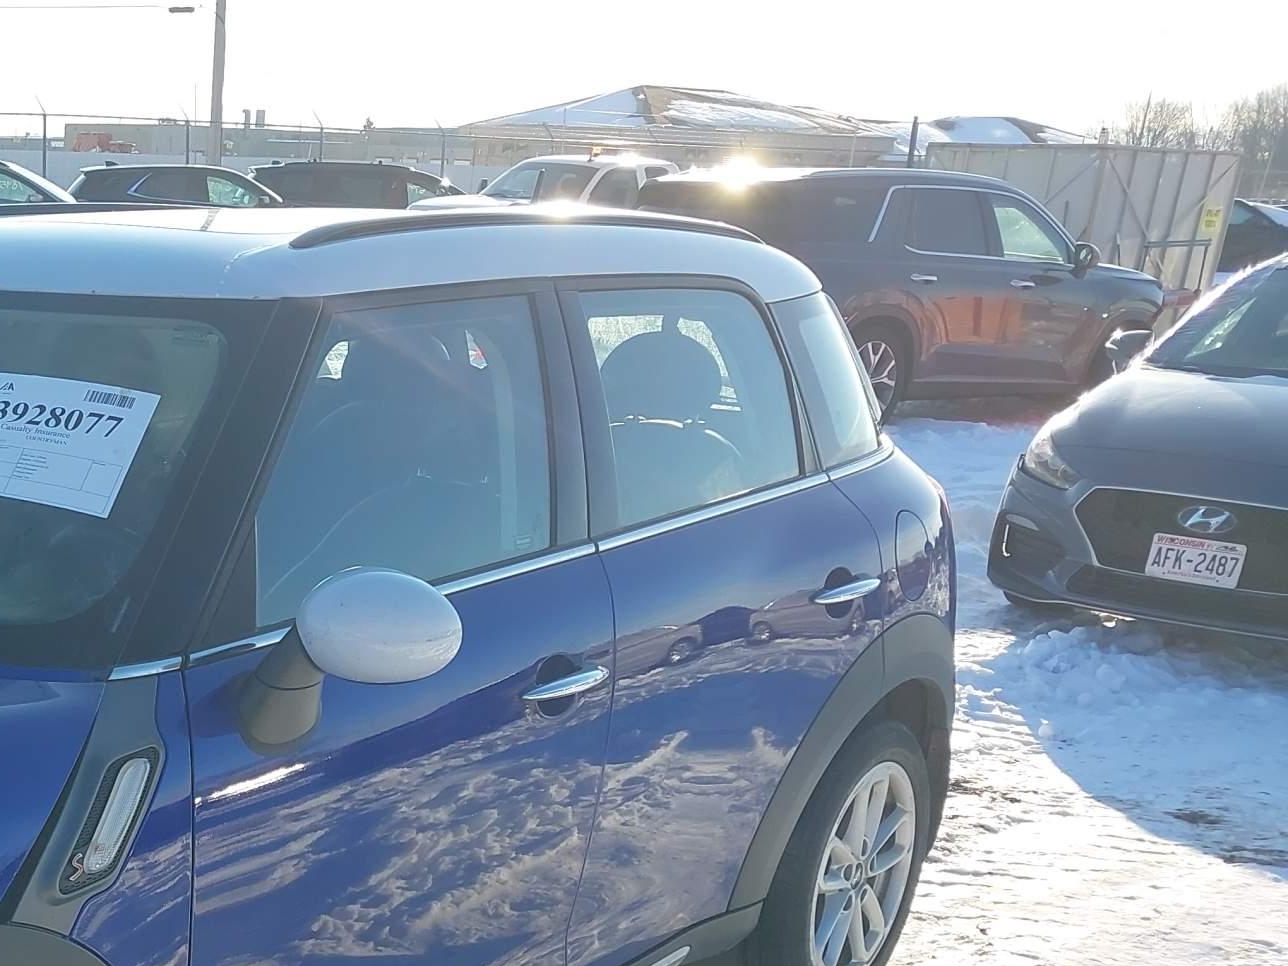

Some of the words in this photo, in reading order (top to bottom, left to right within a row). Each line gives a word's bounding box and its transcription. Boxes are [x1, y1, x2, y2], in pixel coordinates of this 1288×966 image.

[0, 423, 32, 434] Casualty
[34, 428, 71, 440] Insurance
[1157, 535, 1208, 550] WISCONSIN
[1151, 546, 1241, 578] AFK-2487
